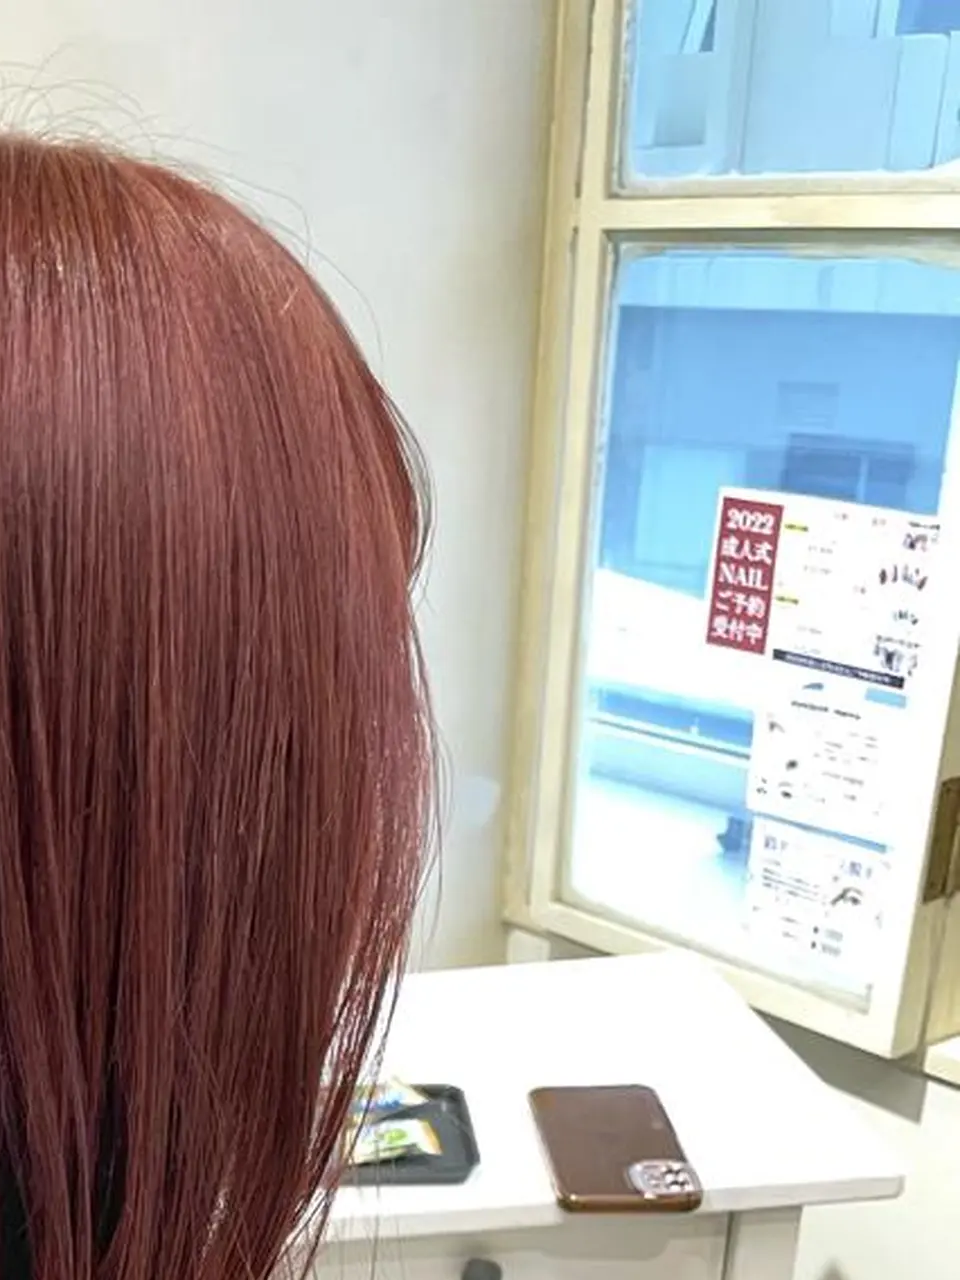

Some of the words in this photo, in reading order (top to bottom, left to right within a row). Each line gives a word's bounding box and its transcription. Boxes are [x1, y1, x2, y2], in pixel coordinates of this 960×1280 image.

[727, 508, 775, 535] 2022
[721, 537, 772, 564] 成人式
[719, 563, 769, 591] NAIL
[715, 591, 766, 618] ご予約
[711, 615, 764, 645] 受付中
